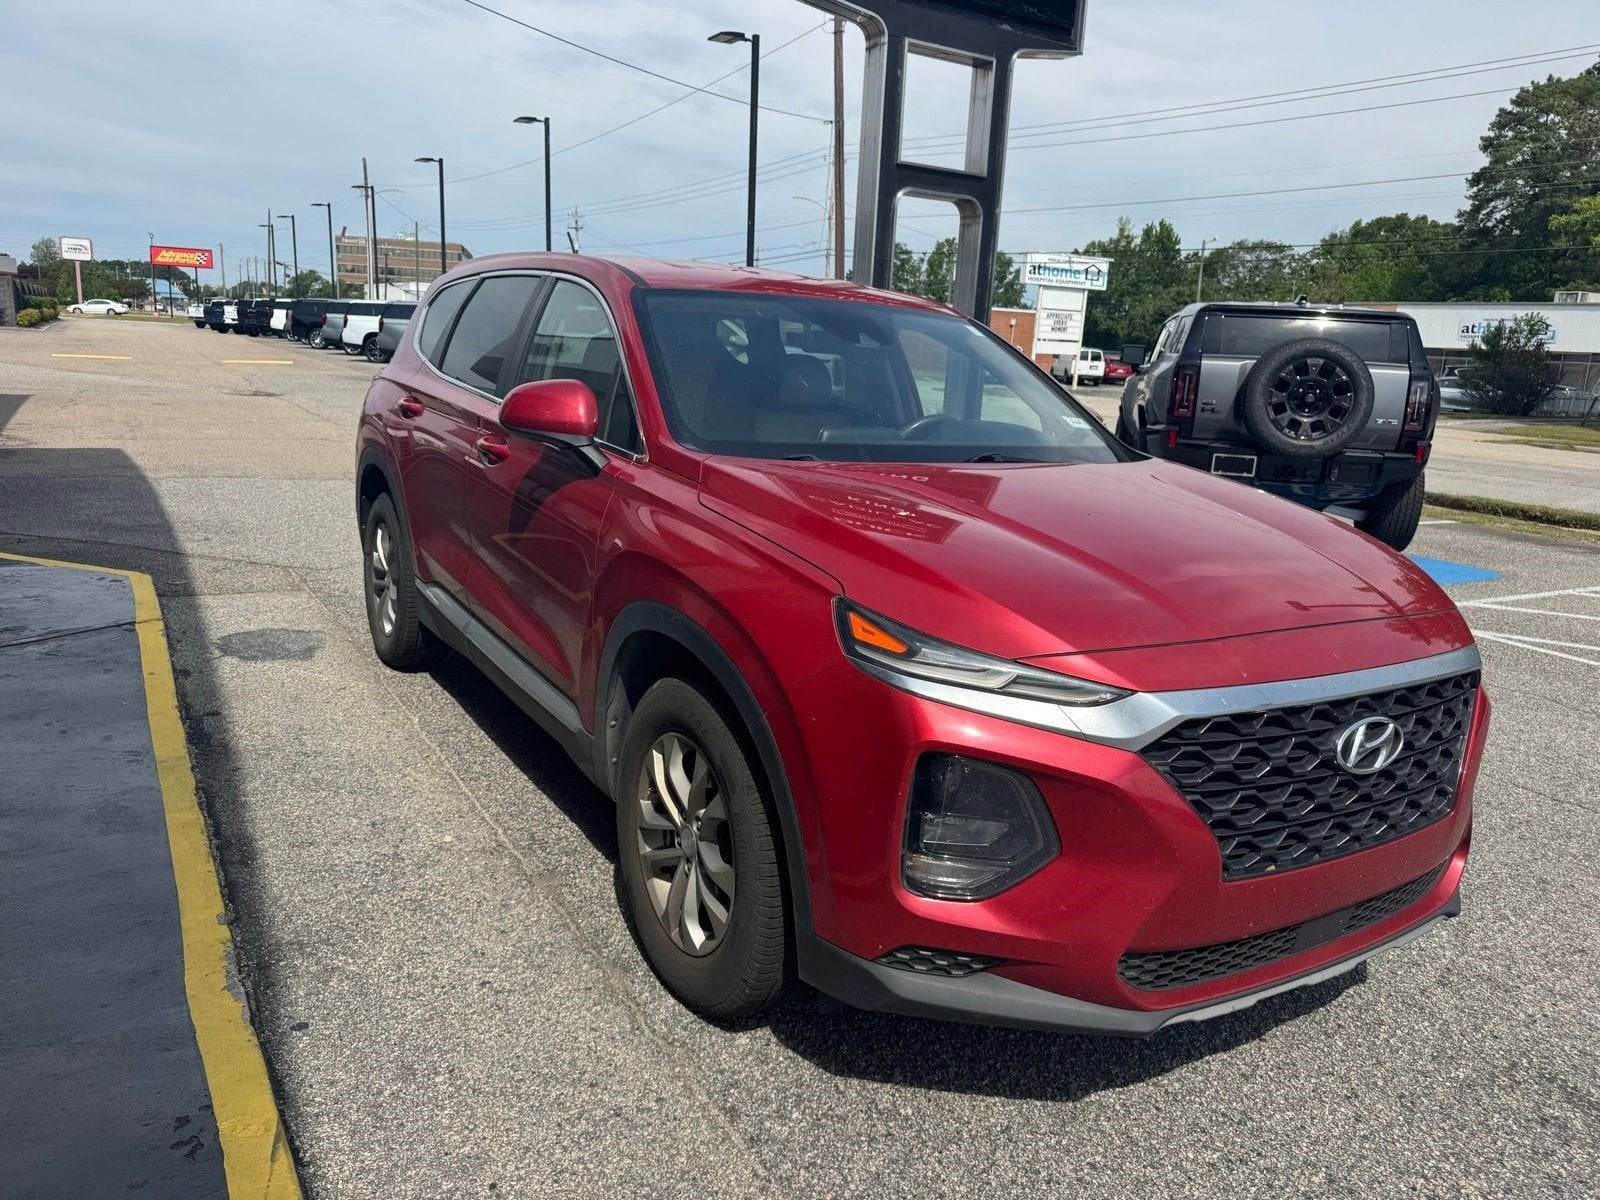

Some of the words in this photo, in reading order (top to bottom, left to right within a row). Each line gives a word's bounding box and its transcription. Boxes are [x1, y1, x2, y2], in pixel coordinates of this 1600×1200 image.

[160, 249, 195, 259] Advance
[1028, 263, 1081, 279] athome
[1027, 276, 1054, 284] HOSPITAL
[1055, 278, 1087, 286] EQUIPMENT
[1046, 312, 1073, 320] APPRECIATE
